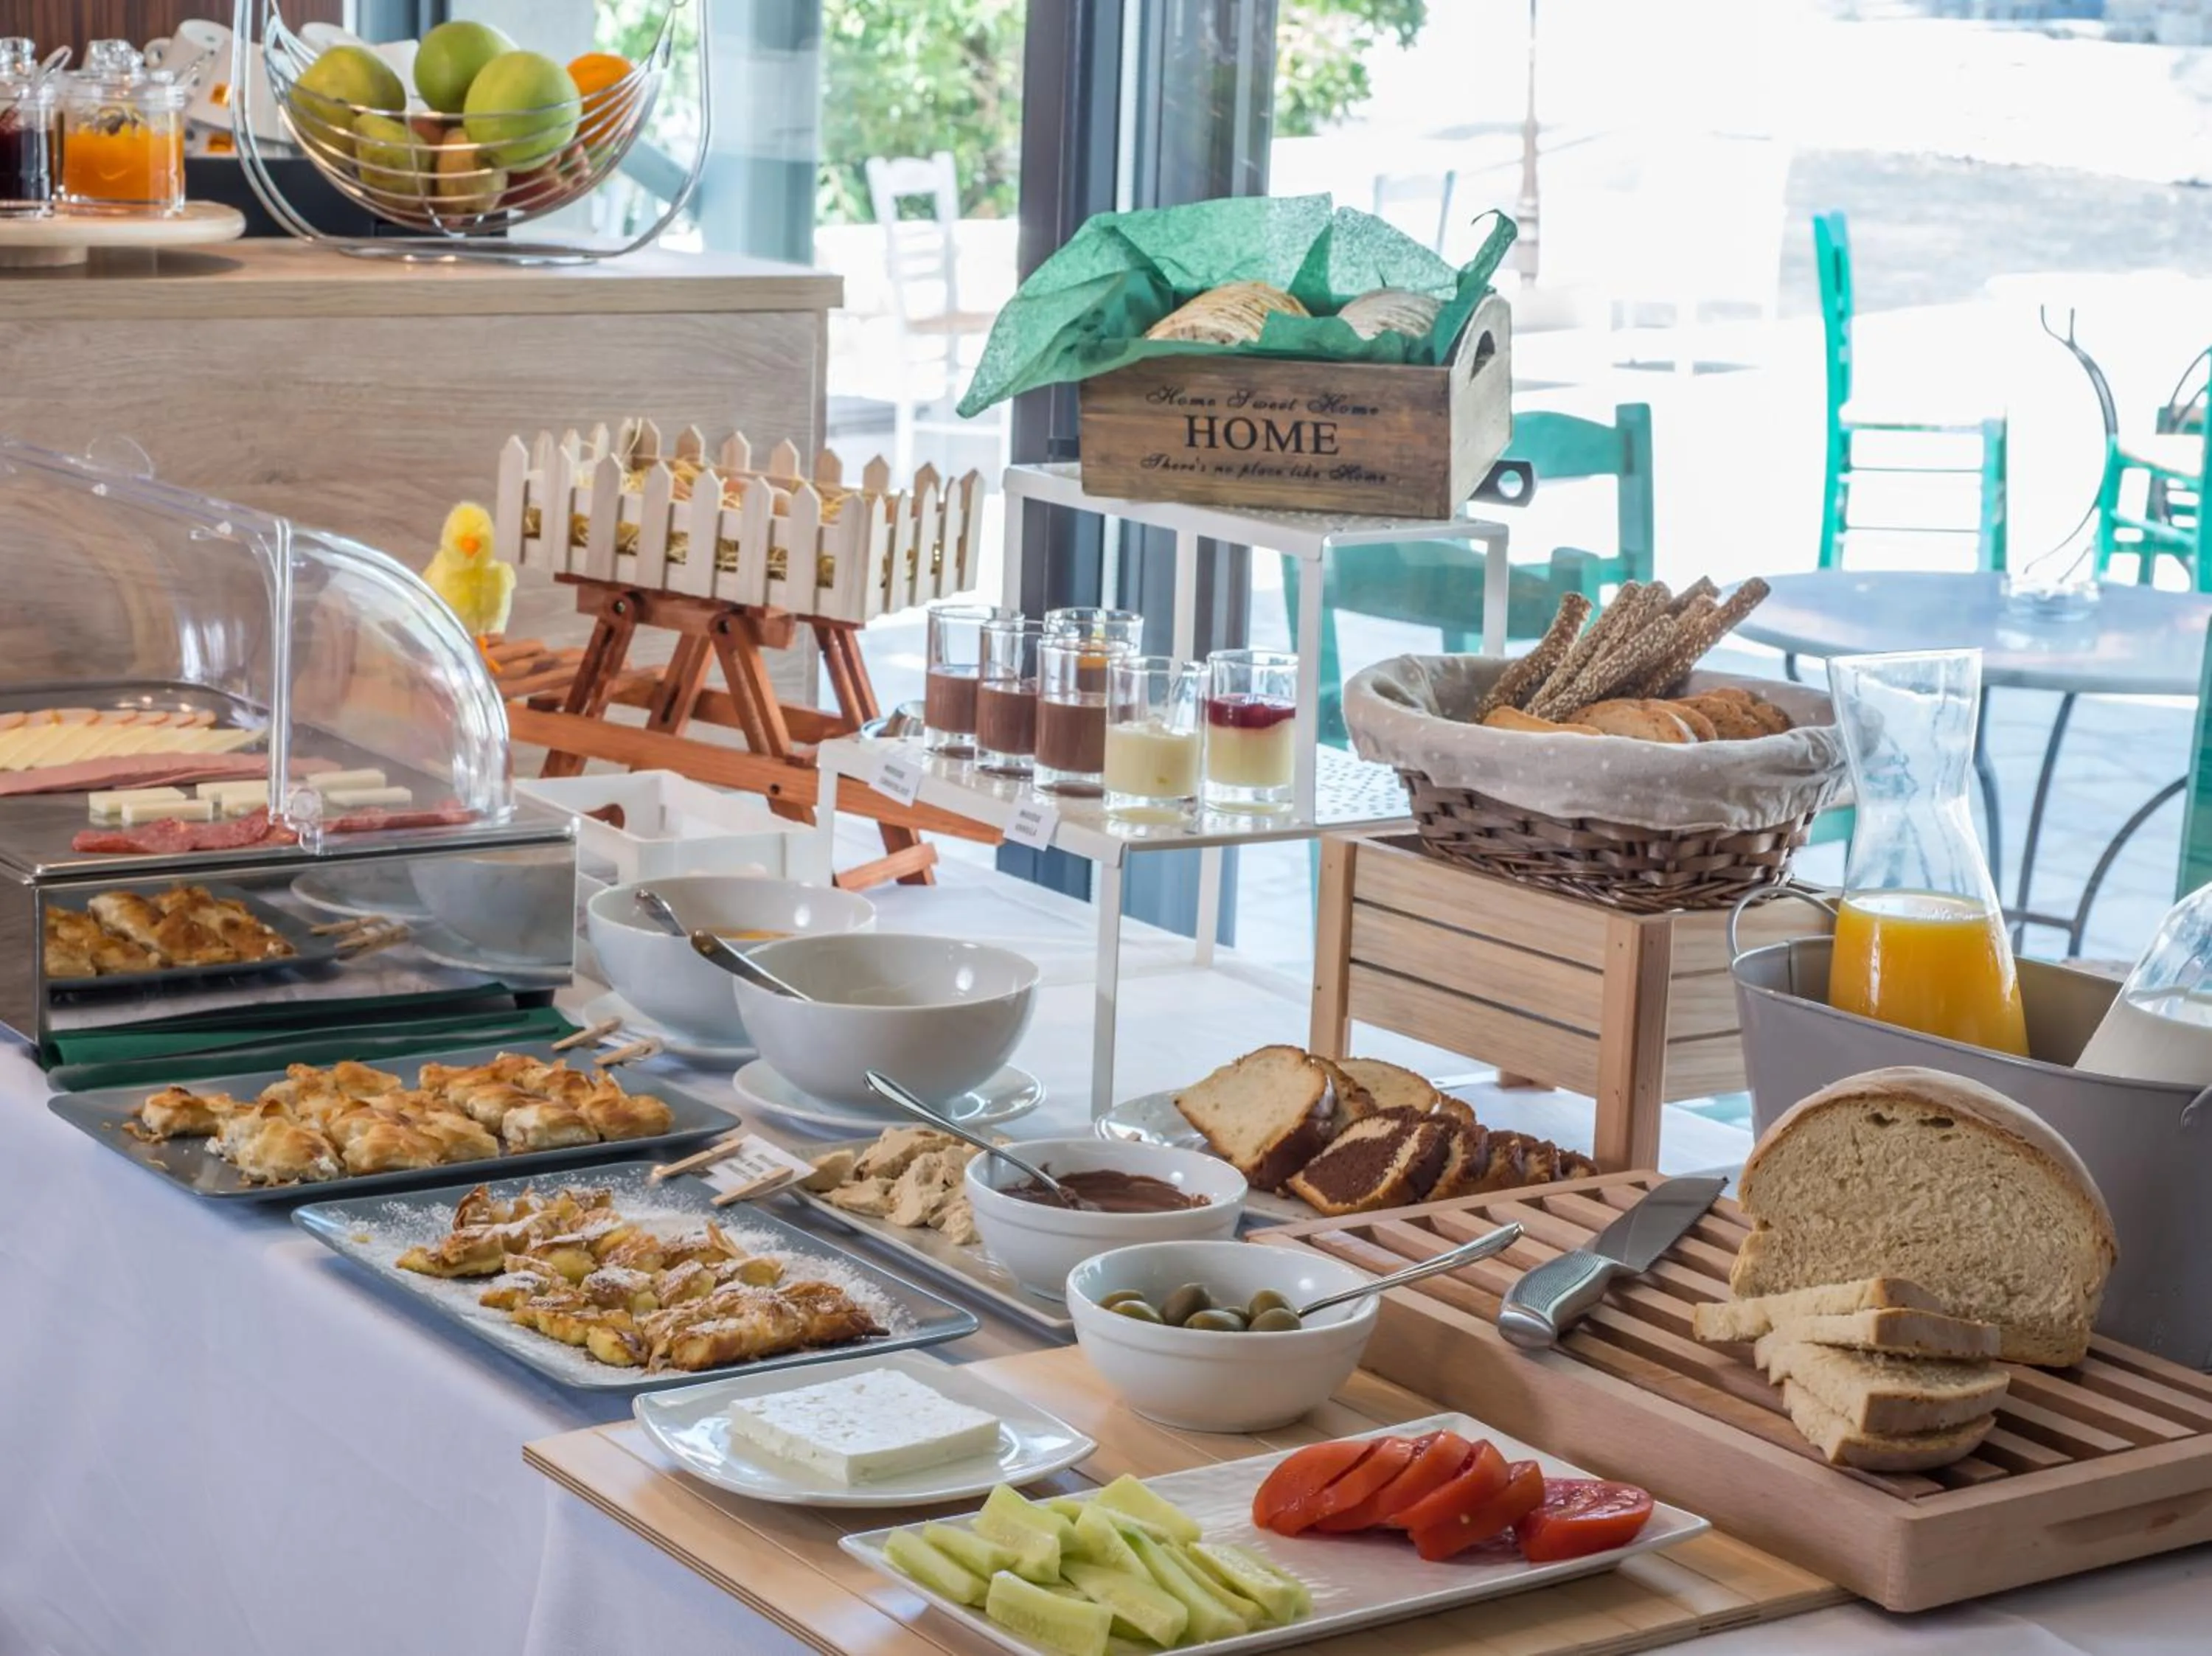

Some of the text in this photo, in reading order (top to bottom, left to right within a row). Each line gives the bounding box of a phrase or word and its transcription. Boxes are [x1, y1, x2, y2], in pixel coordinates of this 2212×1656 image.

[1146, 385, 1379, 415] Home Sweet Home
[1183, 414, 1340, 456] HOME
[1329, 464, 1387, 484] Home
